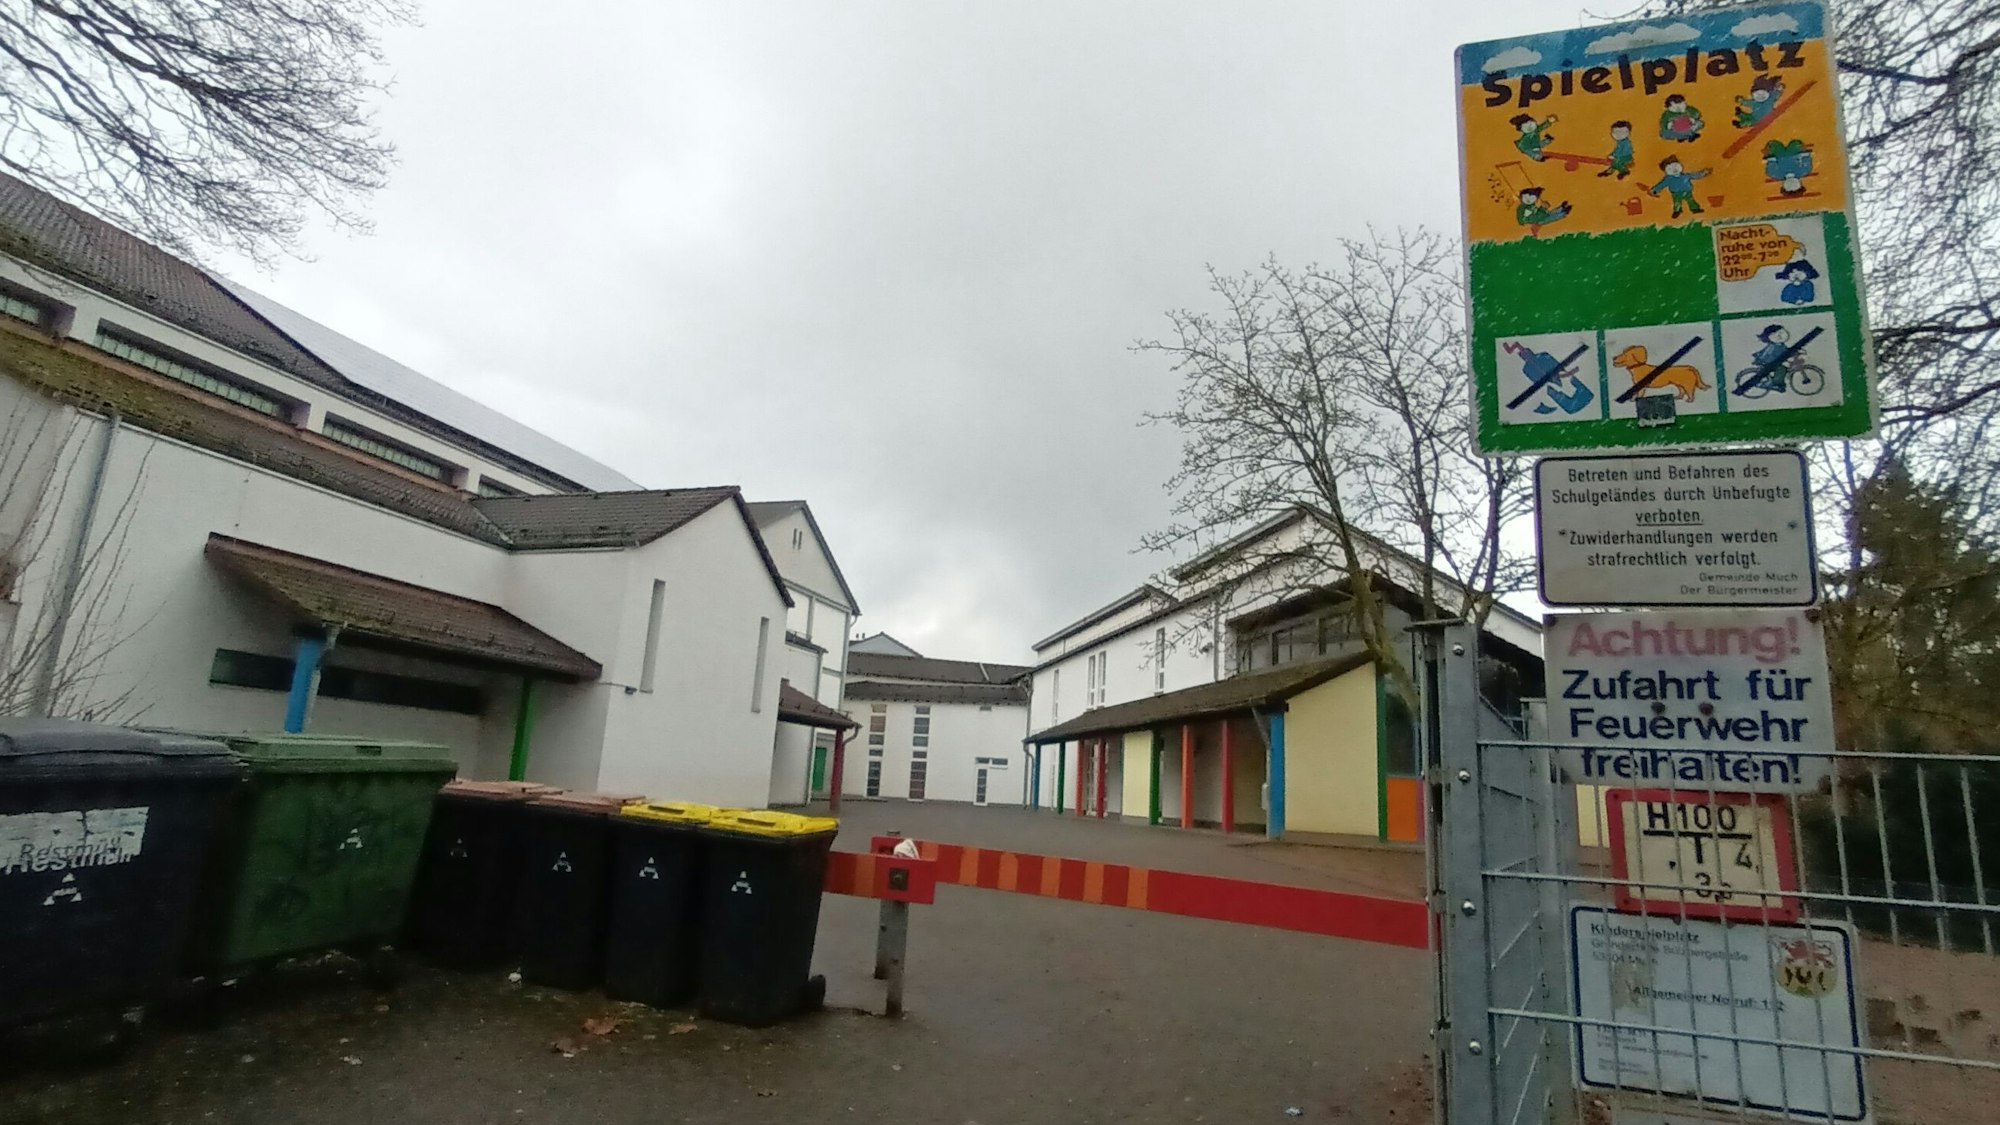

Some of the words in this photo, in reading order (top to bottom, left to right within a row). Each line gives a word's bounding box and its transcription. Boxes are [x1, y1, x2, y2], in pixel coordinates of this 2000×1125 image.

[1482, 41, 1806, 108] Spielplatz
[1720, 228, 1770, 241] Nacht-
[1721, 241, 1754, 253] ruhe
[1760, 239, 1788, 250] von
[1724, 267, 1749, 278] Uhr
[1568, 468, 1627, 482] Betreten
[1635, 467, 1661, 480] und
[1669, 465, 1735, 479] Befahren
[1743, 464, 1769, 478] des
[1552, 488, 1656, 505] Schulgeländes
[1664, 487, 1705, 501] durch
[1712, 486, 1791, 502] Unbefugte
[1569, 530, 1713, 547] Zuwiderhandlungen
[1721, 531, 1778, 543] werden
[1588, 552, 1687, 566] strafrechtlich
[1695, 551, 1761, 568] verfolgt.
[1699, 572, 1760, 583] Gemeinde
[1765, 573, 1798, 581] Much
[1680, 585, 1702, 595] Der
[1708, 585, 1798, 596] Bürgermeister
[1568, 617, 1800, 664] Achtung!
[1562, 670, 1722, 700] Zufahrt
[1746, 669, 1812, 701] für
[1570, 708, 1808, 742] Feuerwehr
[1581, 750, 1801, 784] freihaten!
